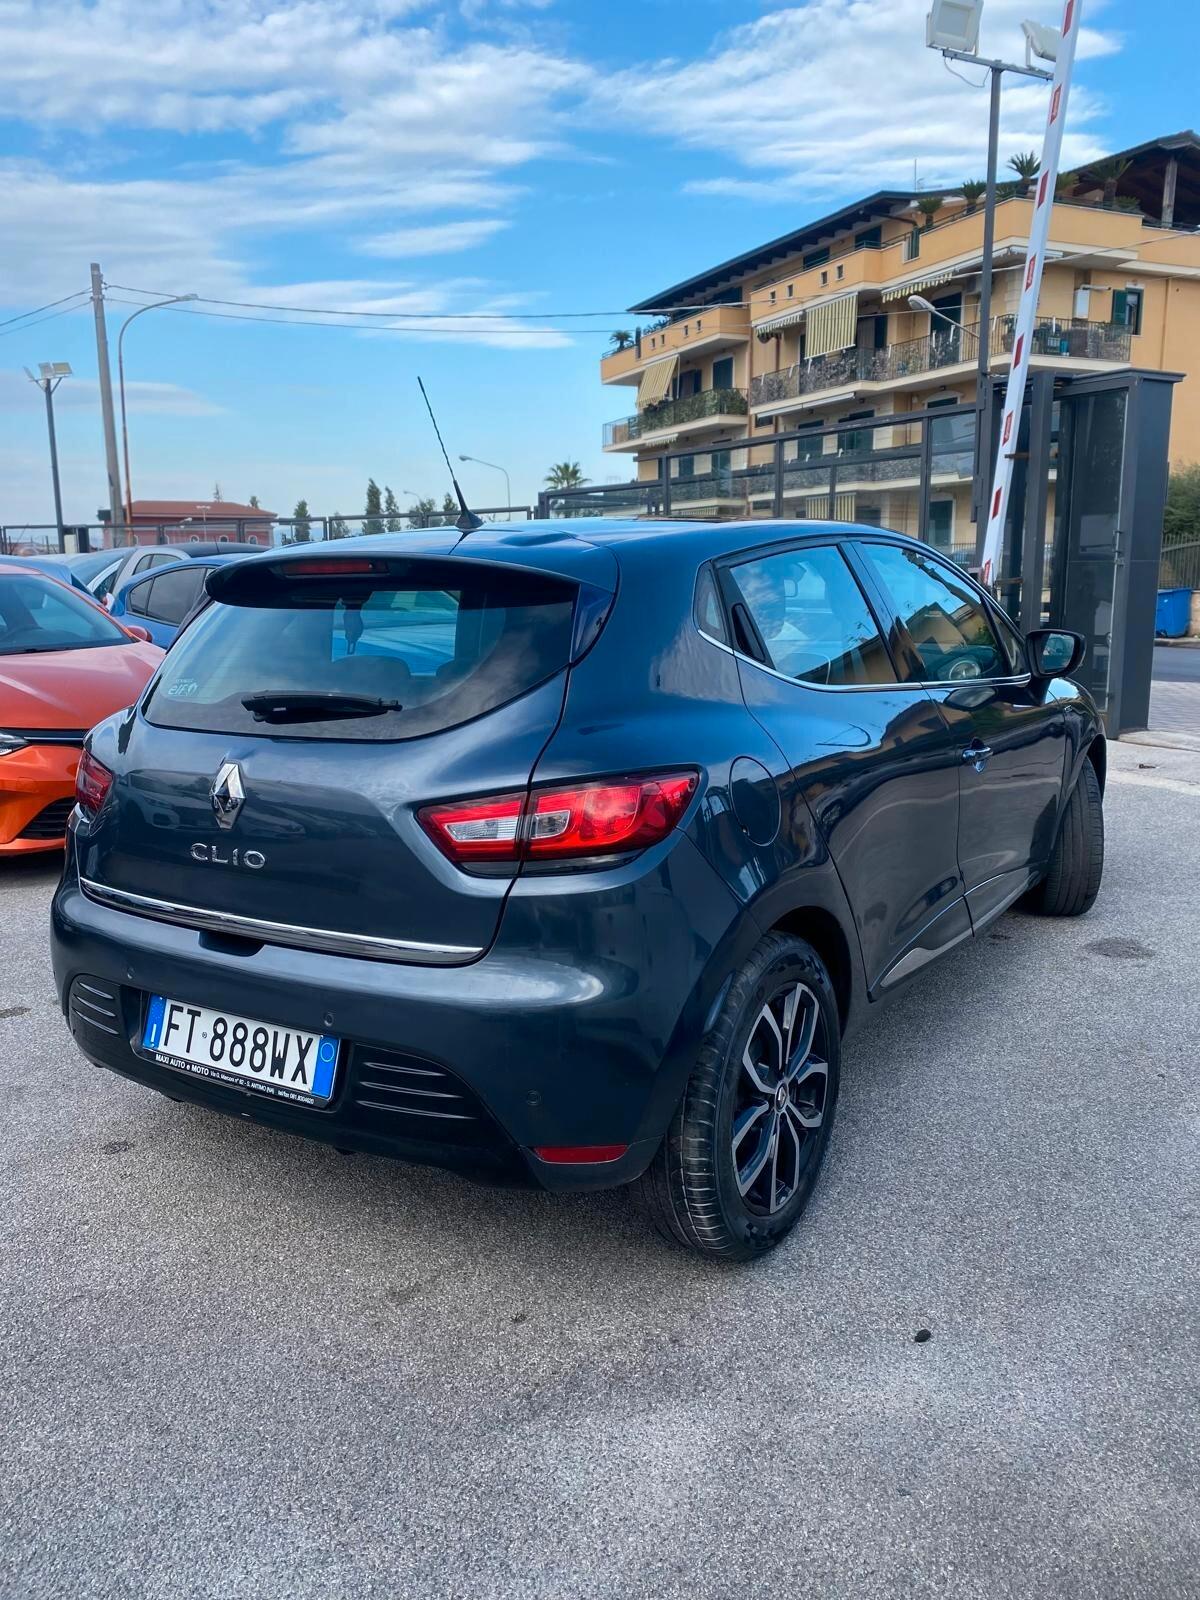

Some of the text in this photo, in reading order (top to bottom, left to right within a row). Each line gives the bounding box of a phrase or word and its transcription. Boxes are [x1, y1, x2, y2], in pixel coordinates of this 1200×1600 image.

[190, 842, 266, 869] CLIO
[163, 1003, 313, 1084] FT 888WX
[155, 1053, 169, 1065] MAXI
[170, 1058, 186, 1069] AUTO
[191, 1064, 209, 1076] MOTO
